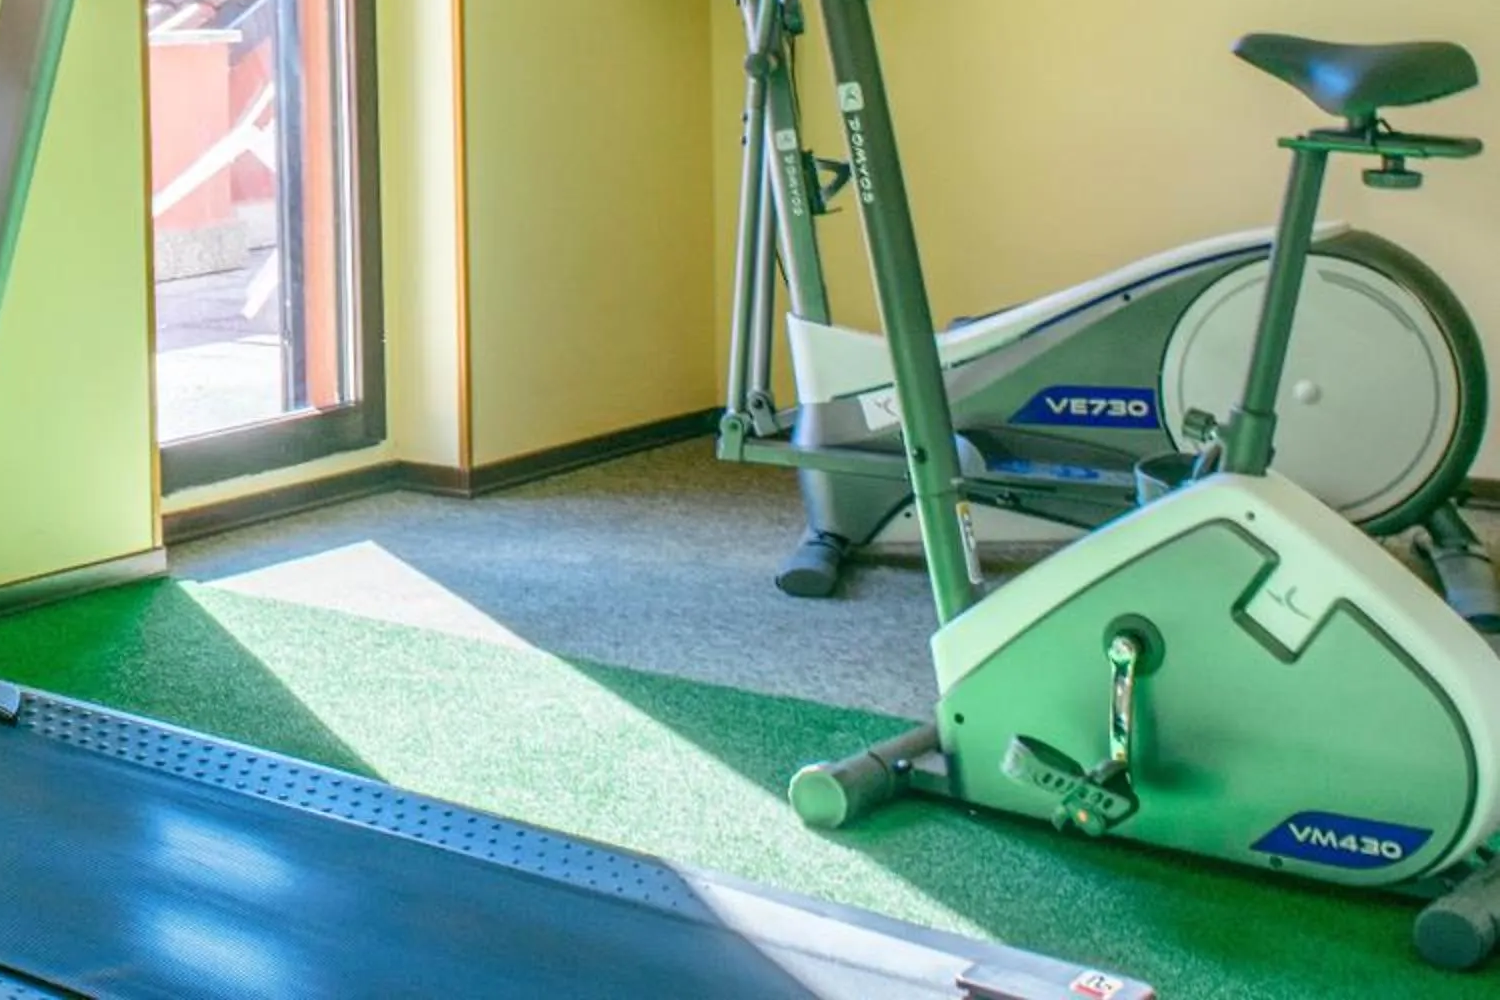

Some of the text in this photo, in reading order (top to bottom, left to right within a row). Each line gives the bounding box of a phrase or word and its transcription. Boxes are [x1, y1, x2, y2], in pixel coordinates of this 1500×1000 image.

[848, 116, 874, 204] DOMYOS
[1045, 397, 1149, 417] VE730
[1288, 822, 1404, 860] VM430
